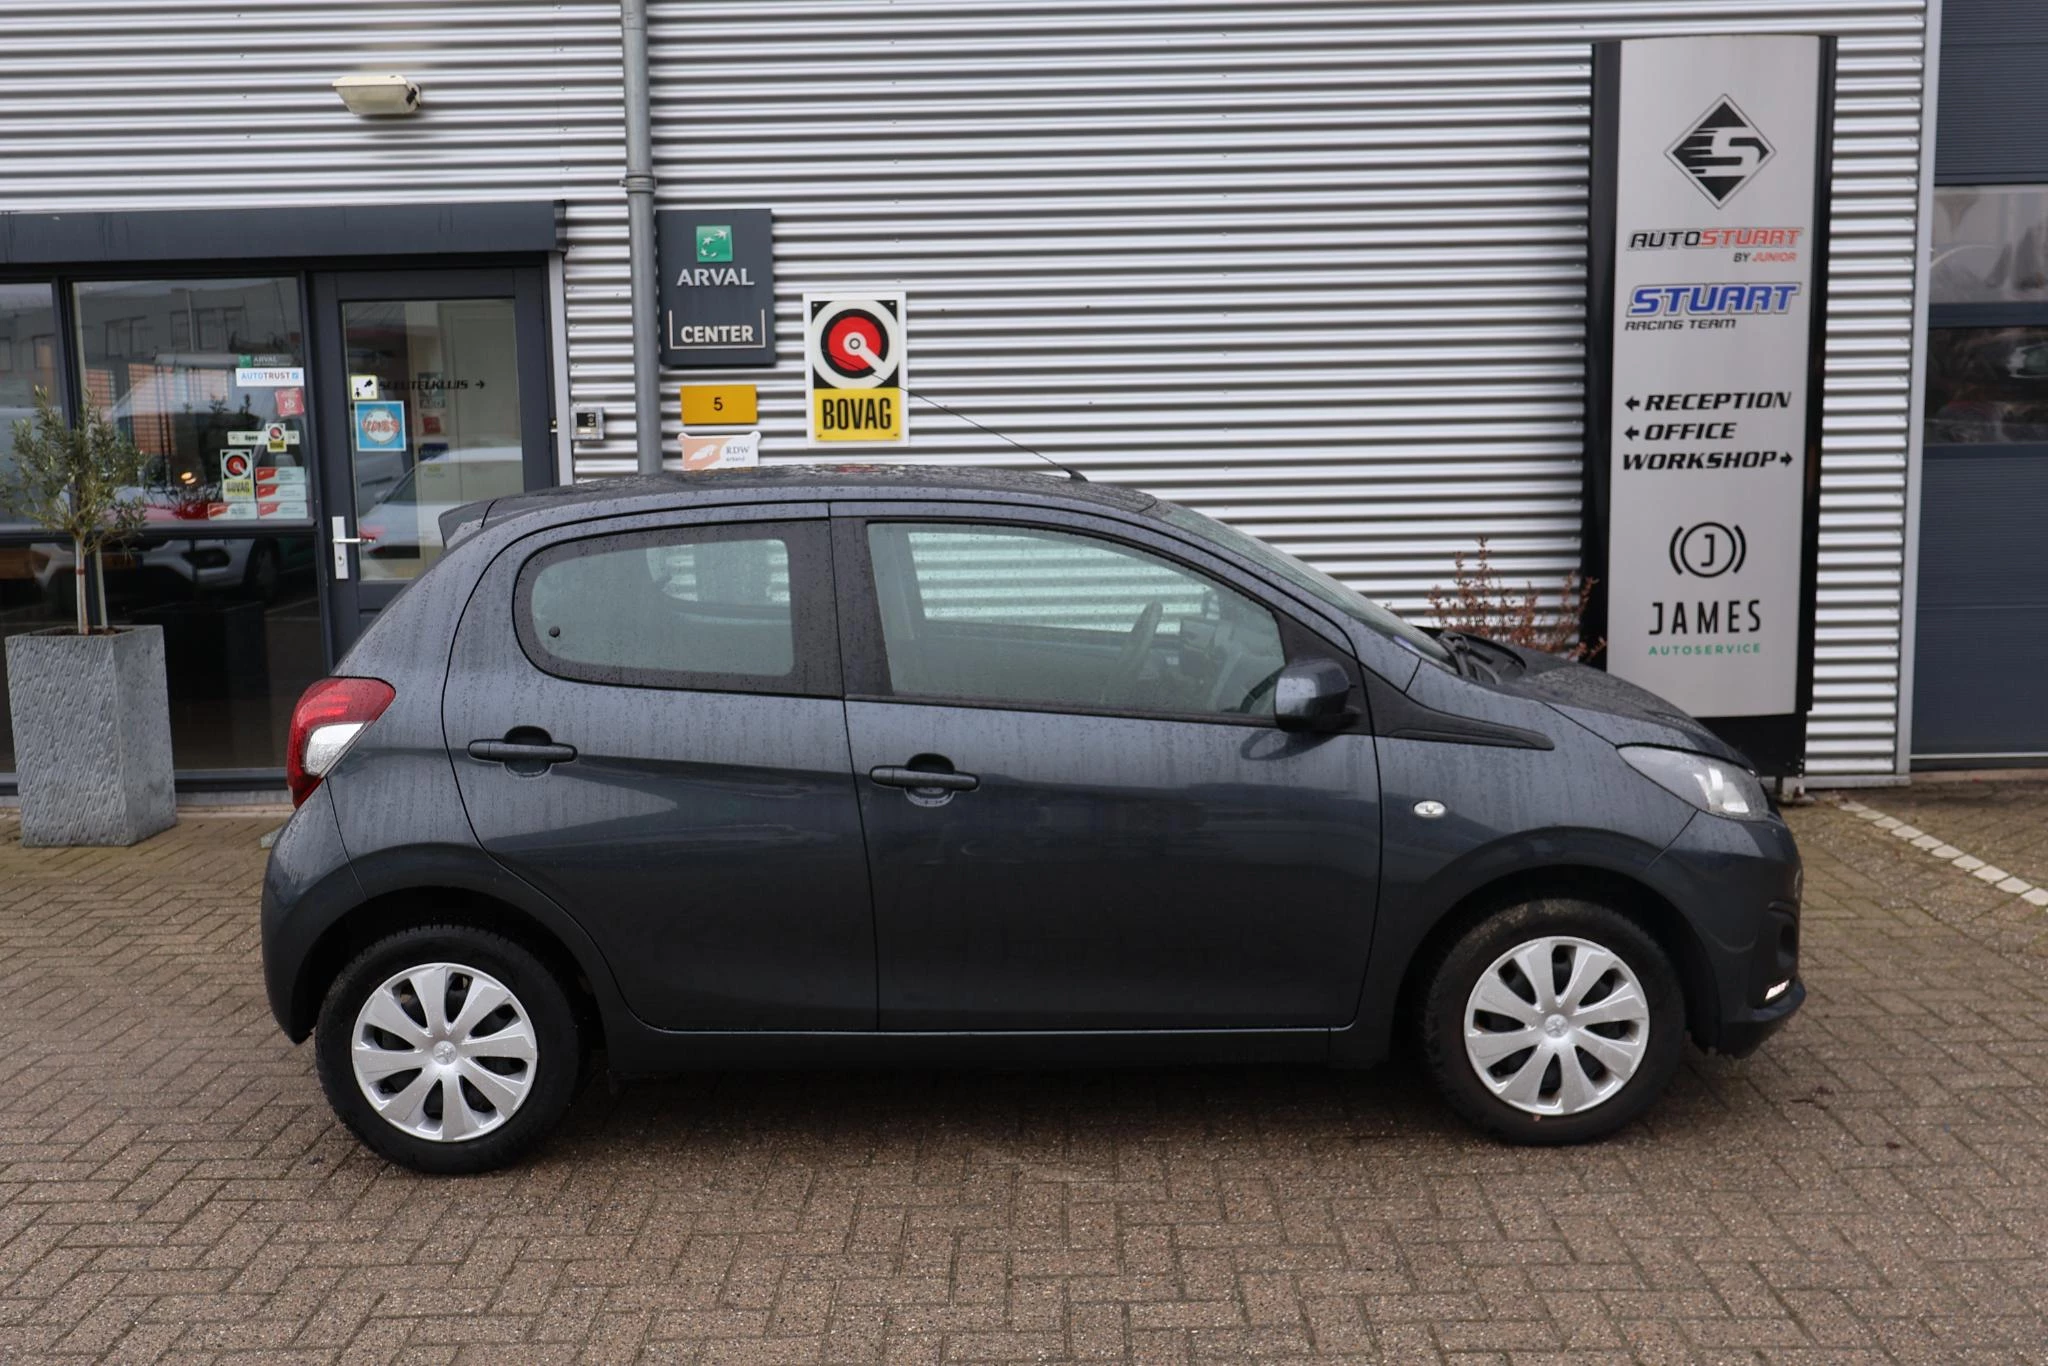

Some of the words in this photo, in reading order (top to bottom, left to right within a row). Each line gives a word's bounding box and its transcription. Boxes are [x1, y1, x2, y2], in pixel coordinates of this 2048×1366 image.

[1630, 229, 1801, 249] AUTOSTUART
[1733, 252, 1751, 262] BY
[1752, 251, 1797, 262] JUNIOR
[676, 268, 755, 288] ARVAL
[1628, 284, 1800, 315] STUART
[680, 325, 754, 343] CENTER
[1624, 319, 1684, 332] RACING
[1689, 318, 1737, 330] TEAM
[241, 371, 290, 380] AUTOTRUST
[713, 396, 723, 411] 5
[1644, 391, 1792, 411] RECEPTION
[822, 397, 892, 431] BOVAG
[1644, 422, 1738, 441] OFFICE
[1622, 451, 1777, 471] WORKSHOP
[1648, 599, 1762, 636] JAMES
[1648, 643, 1762, 656] AUTOSERVICE
